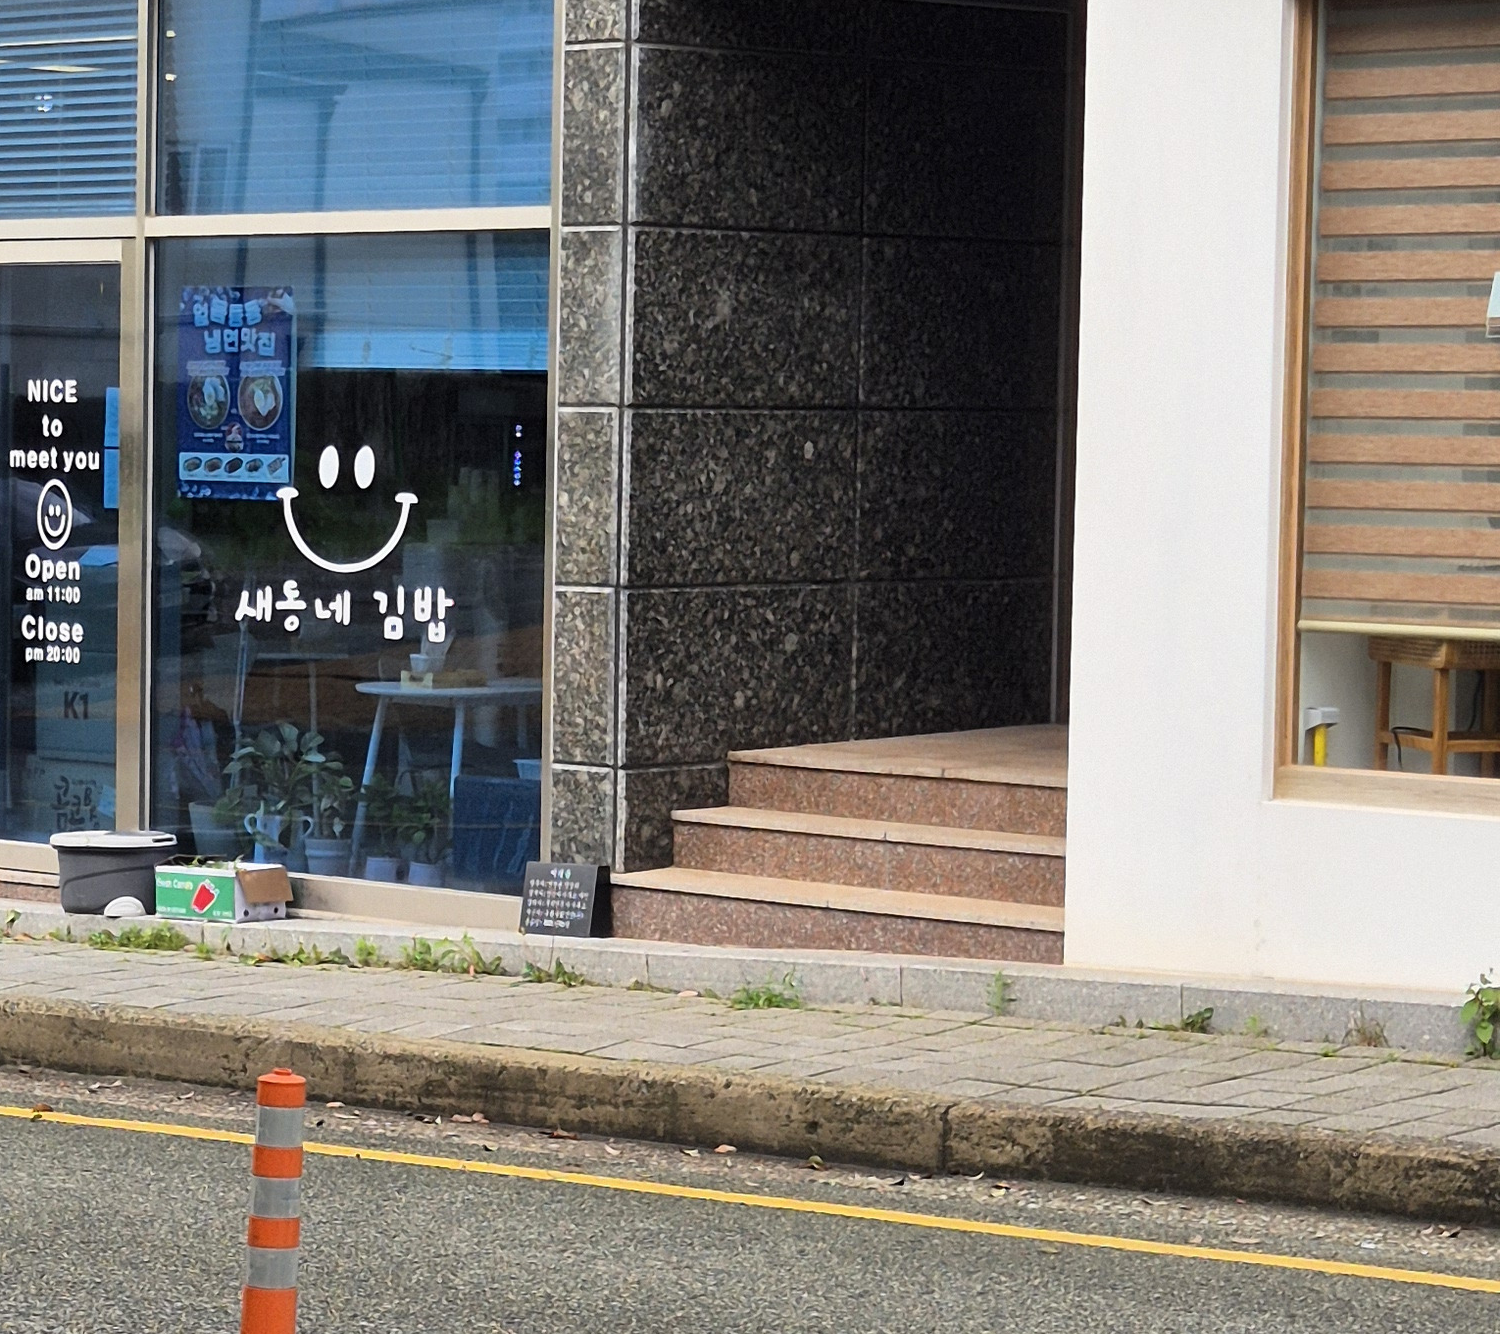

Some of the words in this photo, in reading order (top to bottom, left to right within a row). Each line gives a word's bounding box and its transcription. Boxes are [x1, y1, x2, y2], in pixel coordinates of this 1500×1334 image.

[27, 379, 78, 403] NICE
[42, 414, 63, 437] to
[9, 447, 58, 469] meet
[63, 450, 100, 472] you
[25, 553, 80, 582] Open
[25, 588, 44, 602] am
[46, 586, 80, 604] 11:00
[234, 579, 350, 632] 새동네
[373, 585, 454, 643] 김밥
[21, 615, 84, 643] Close
[25, 646, 44, 662] pm
[46, 646, 80, 664] 20:00
[64, 691, 89, 719] K1
